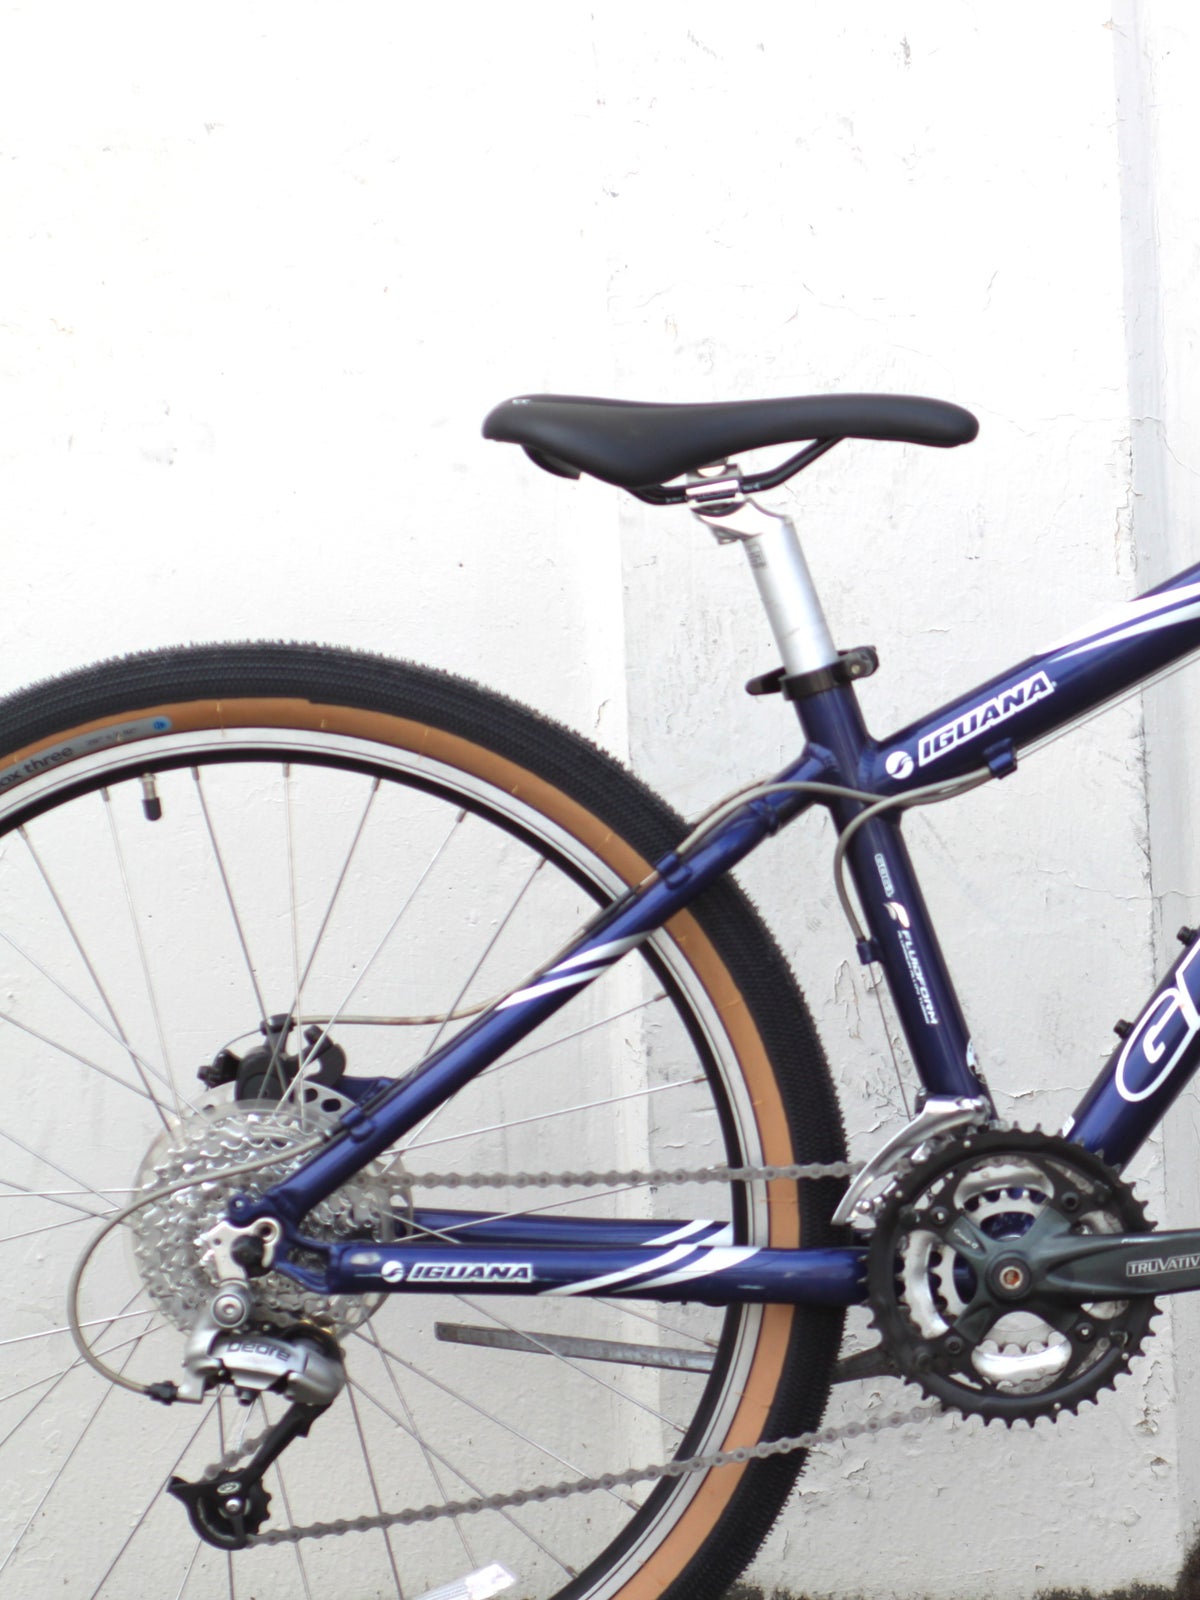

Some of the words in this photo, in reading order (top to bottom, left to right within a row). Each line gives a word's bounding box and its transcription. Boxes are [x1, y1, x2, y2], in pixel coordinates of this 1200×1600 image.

[918, 670, 1055, 767] IGUANA
[0, 770, 21, 786] ox
[23, 746, 73, 773] three
[901, 929, 939, 1025] FLUIDFORM
[406, 1262, 533, 1283] IGUANA
[226, 1339, 291, 1362] Deore
